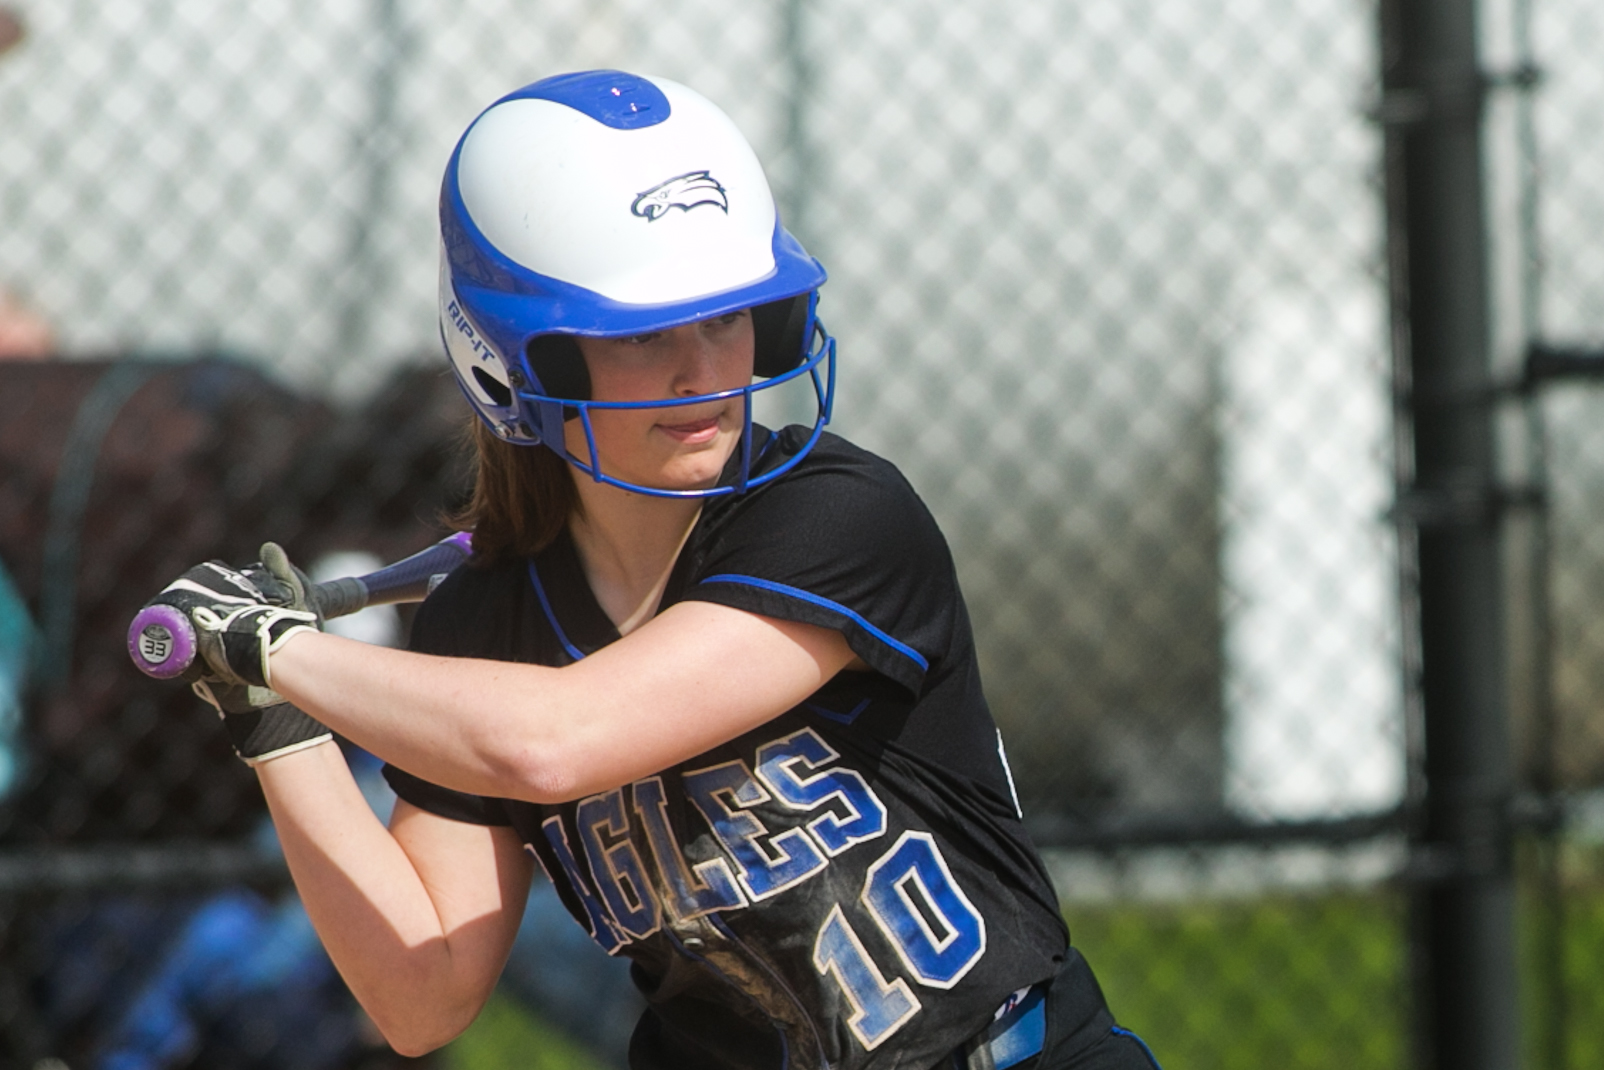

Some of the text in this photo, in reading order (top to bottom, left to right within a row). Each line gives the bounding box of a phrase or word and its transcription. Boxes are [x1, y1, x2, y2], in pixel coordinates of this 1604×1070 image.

[448, 300, 495, 361] RIP-IT
[144, 639, 166, 657] 33
[523, 726, 887, 957] AGLES
[813, 830, 987, 1052] 10
